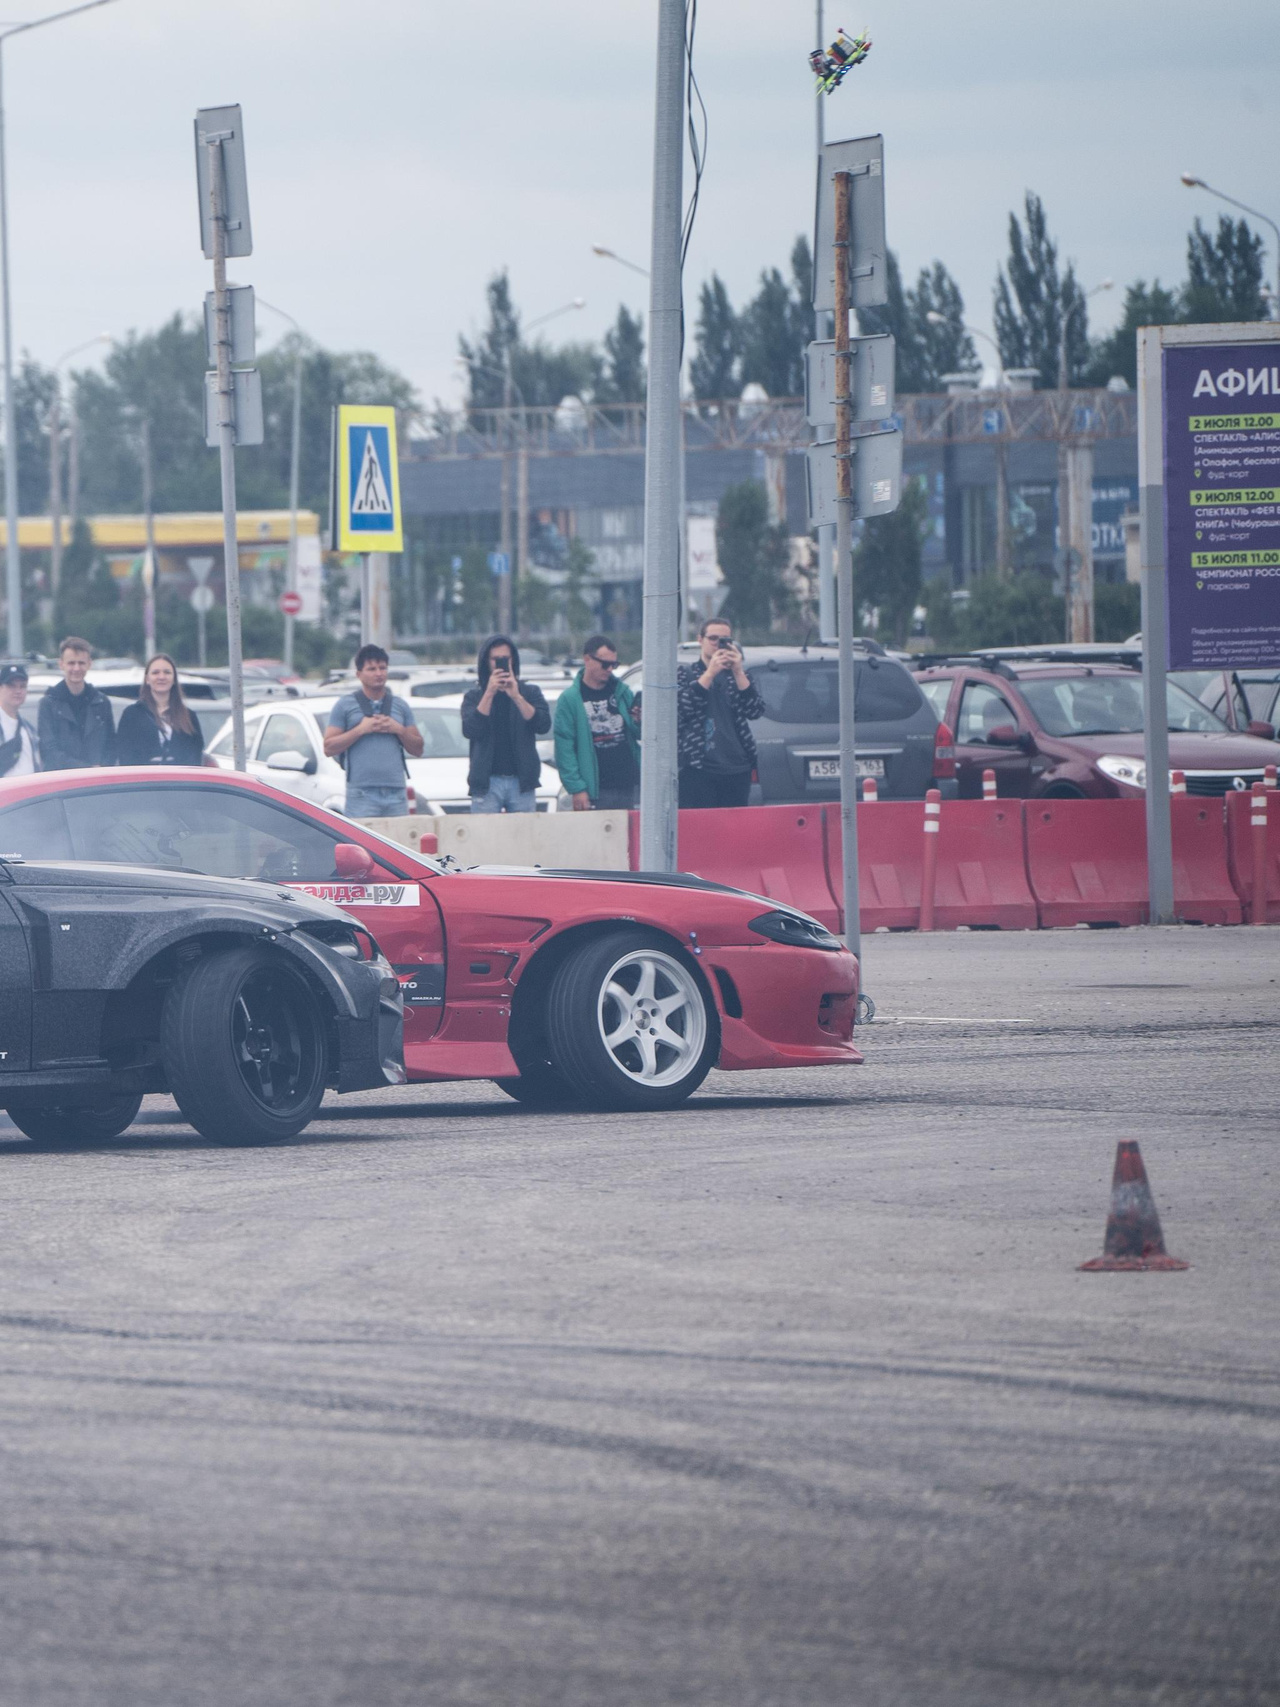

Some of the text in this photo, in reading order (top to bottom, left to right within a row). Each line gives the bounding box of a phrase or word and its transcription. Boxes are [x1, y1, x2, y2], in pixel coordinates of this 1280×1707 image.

[1194, 416, 1273, 429] 2 ИЮЛЯ 12.00
[1193, 433, 1248, 443] СПЕКТАКЛЬ
[1195, 490, 1275, 503] 9 ИЮЛЯ 12.00
[1195, 507, 1250, 517] СПЕКТАКЛЬ
[1195, 520, 1230, 529] КНИГА»
[1196, 552, 1280, 565] 15 ИЮЛЯ 11.00
[1196, 569, 1253, 579] ЧЕМПИОНАТ
[1207, 582, 1250, 591] парковка
